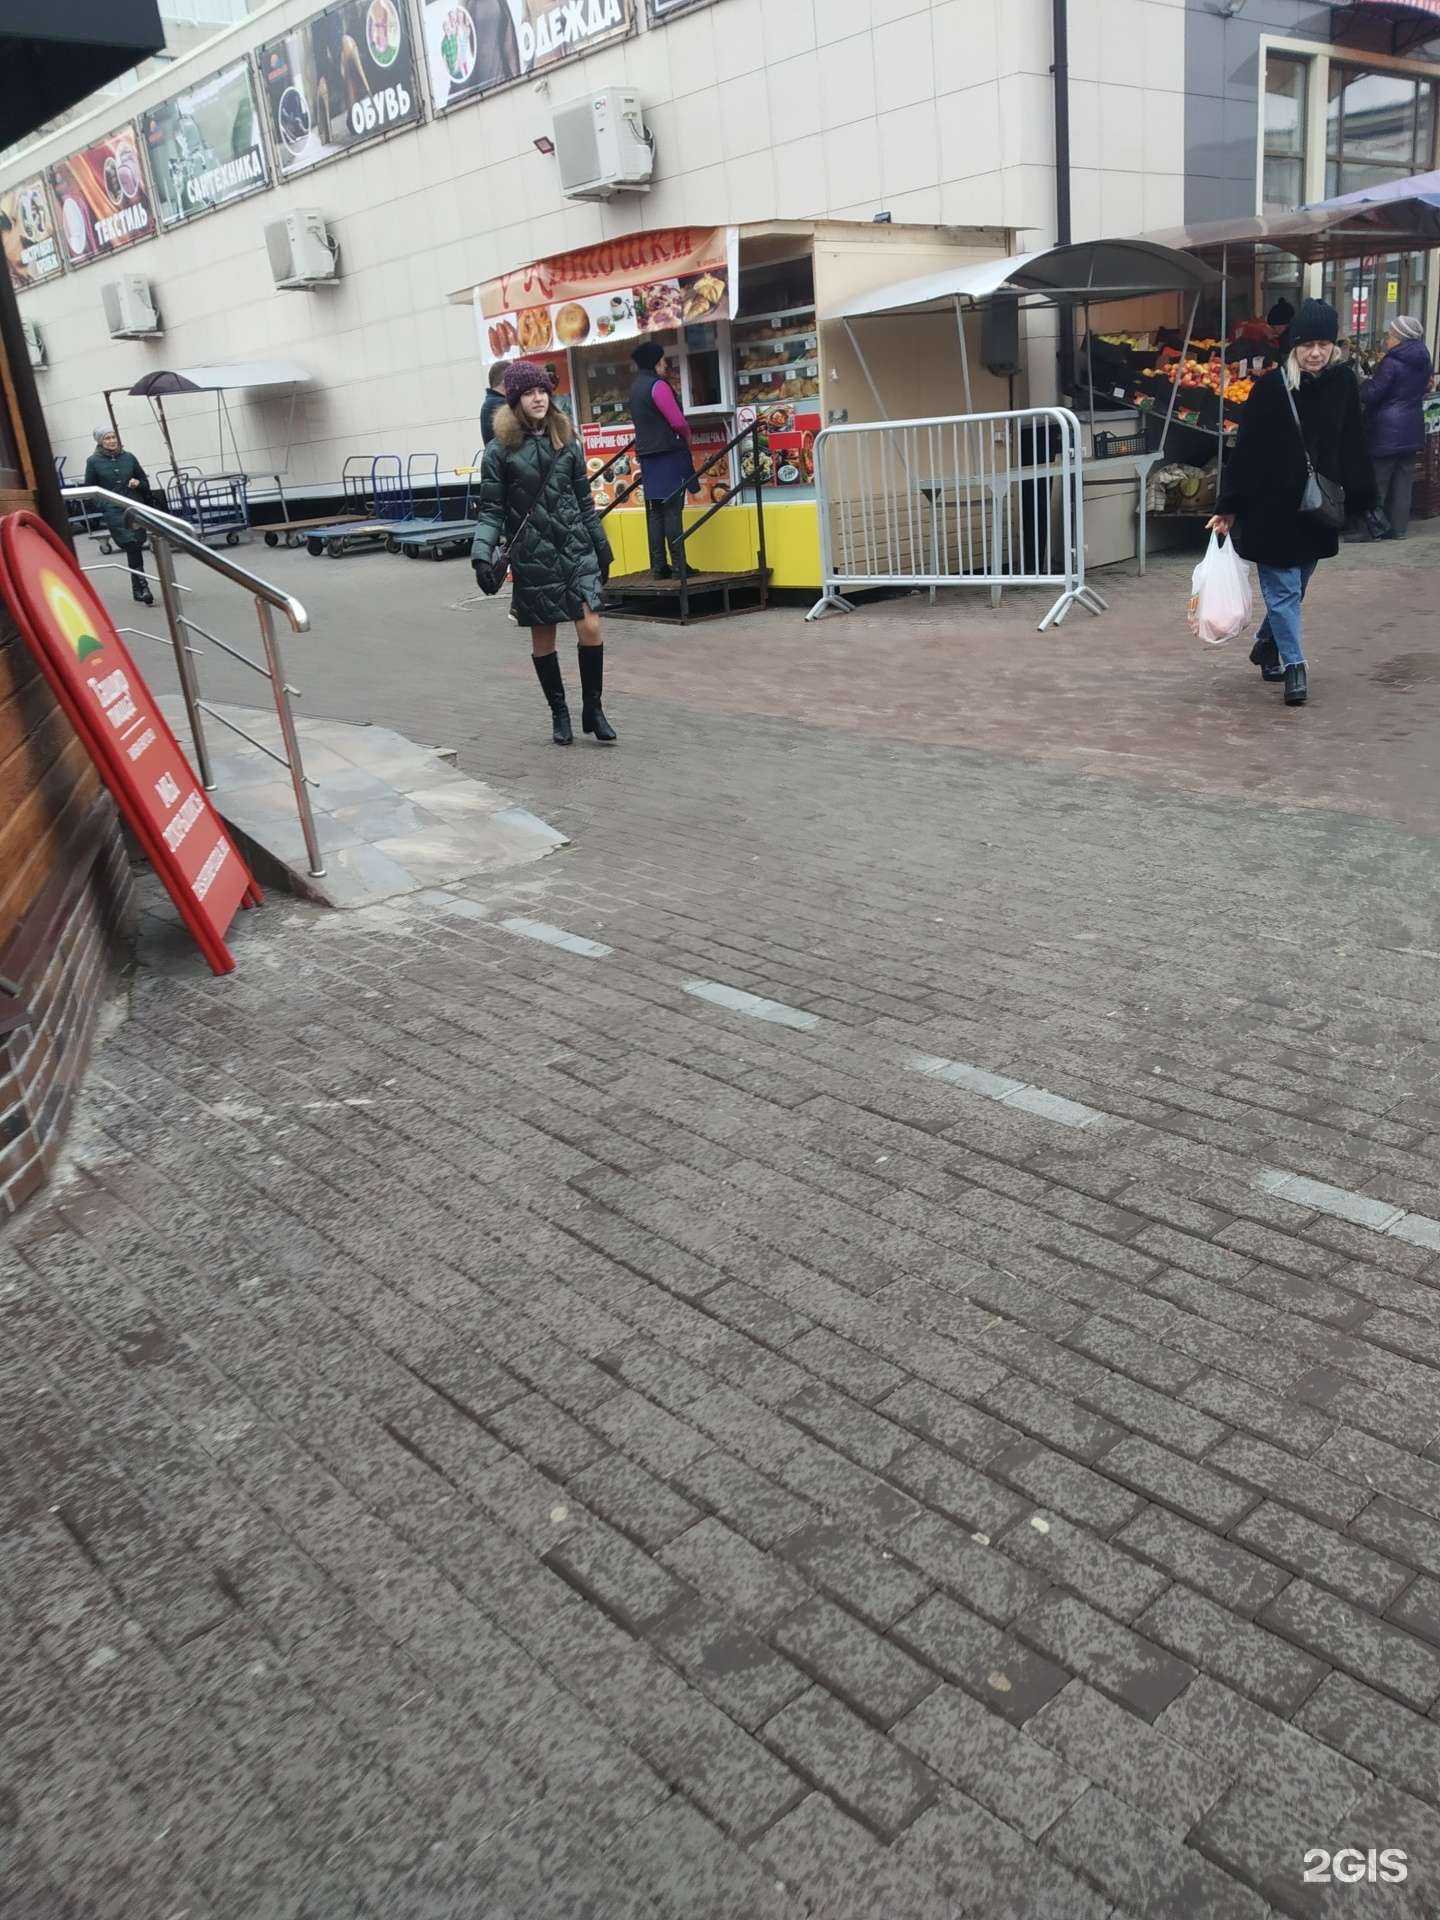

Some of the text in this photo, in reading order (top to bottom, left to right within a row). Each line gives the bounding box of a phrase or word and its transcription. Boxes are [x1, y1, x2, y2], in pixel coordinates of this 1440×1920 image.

[518, 0, 622, 63] ОДЕЖДА
[351, 82, 411, 134] ОБУВЬ
[186, 149, 263, 204] САНТЕХНИКА
[94, 202, 148, 246] ТЕКСТИЛЬ
